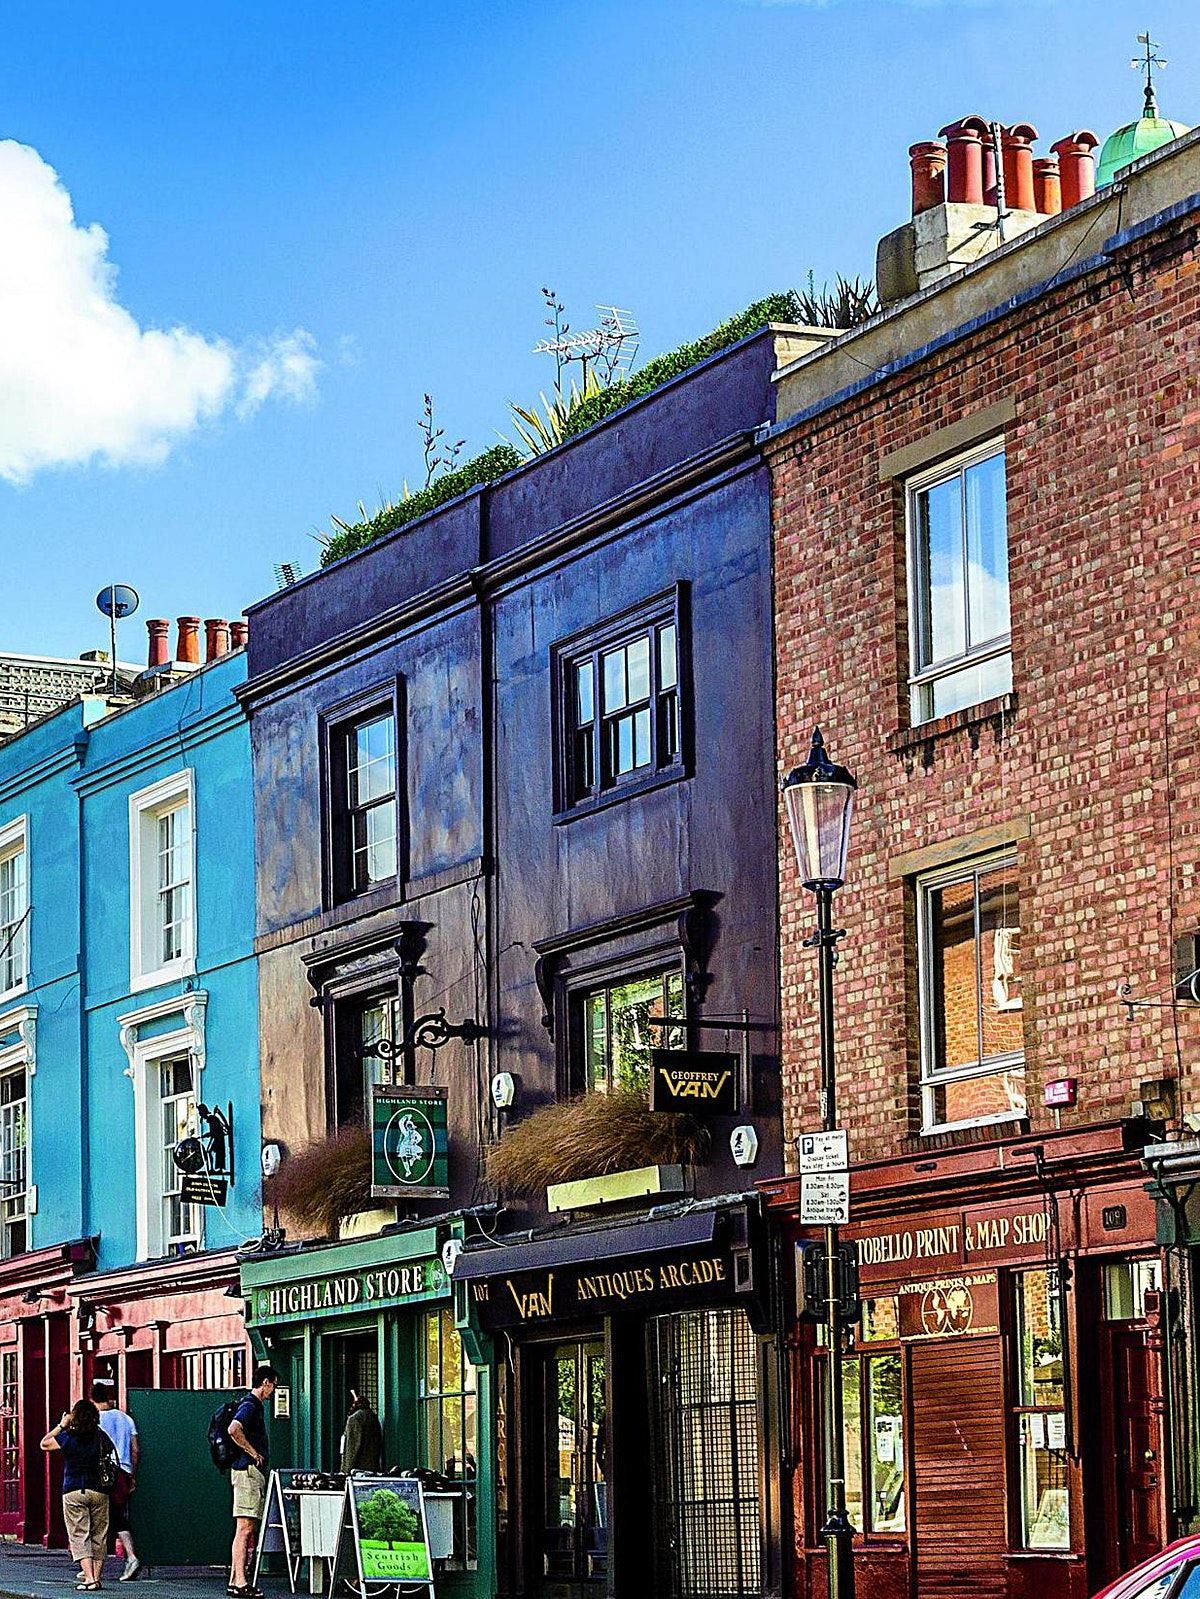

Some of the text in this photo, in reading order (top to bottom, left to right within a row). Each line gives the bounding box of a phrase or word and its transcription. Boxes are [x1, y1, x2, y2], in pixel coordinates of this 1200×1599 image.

[659, 1068, 731, 1098] VAN
[671, 1070, 719, 1081] GEOFFREY
[855, 1212, 1050, 1266] TOBELLO PRINT & MAP SHOP
[269, 1265, 423, 1315] HIGHLAND STORE
[577, 1258, 726, 1300] ANTIQUES ARCADE
[898, 1280, 935, 1294] ANTIQUE
[935, 1277, 964, 1289] PRINTS
[972, 1273, 997, 1285] MAPS
[506, 1274, 554, 1319] VAN
[367, 1552, 419, 1561] Scottish
[377, 1562, 412, 1571] Goods
